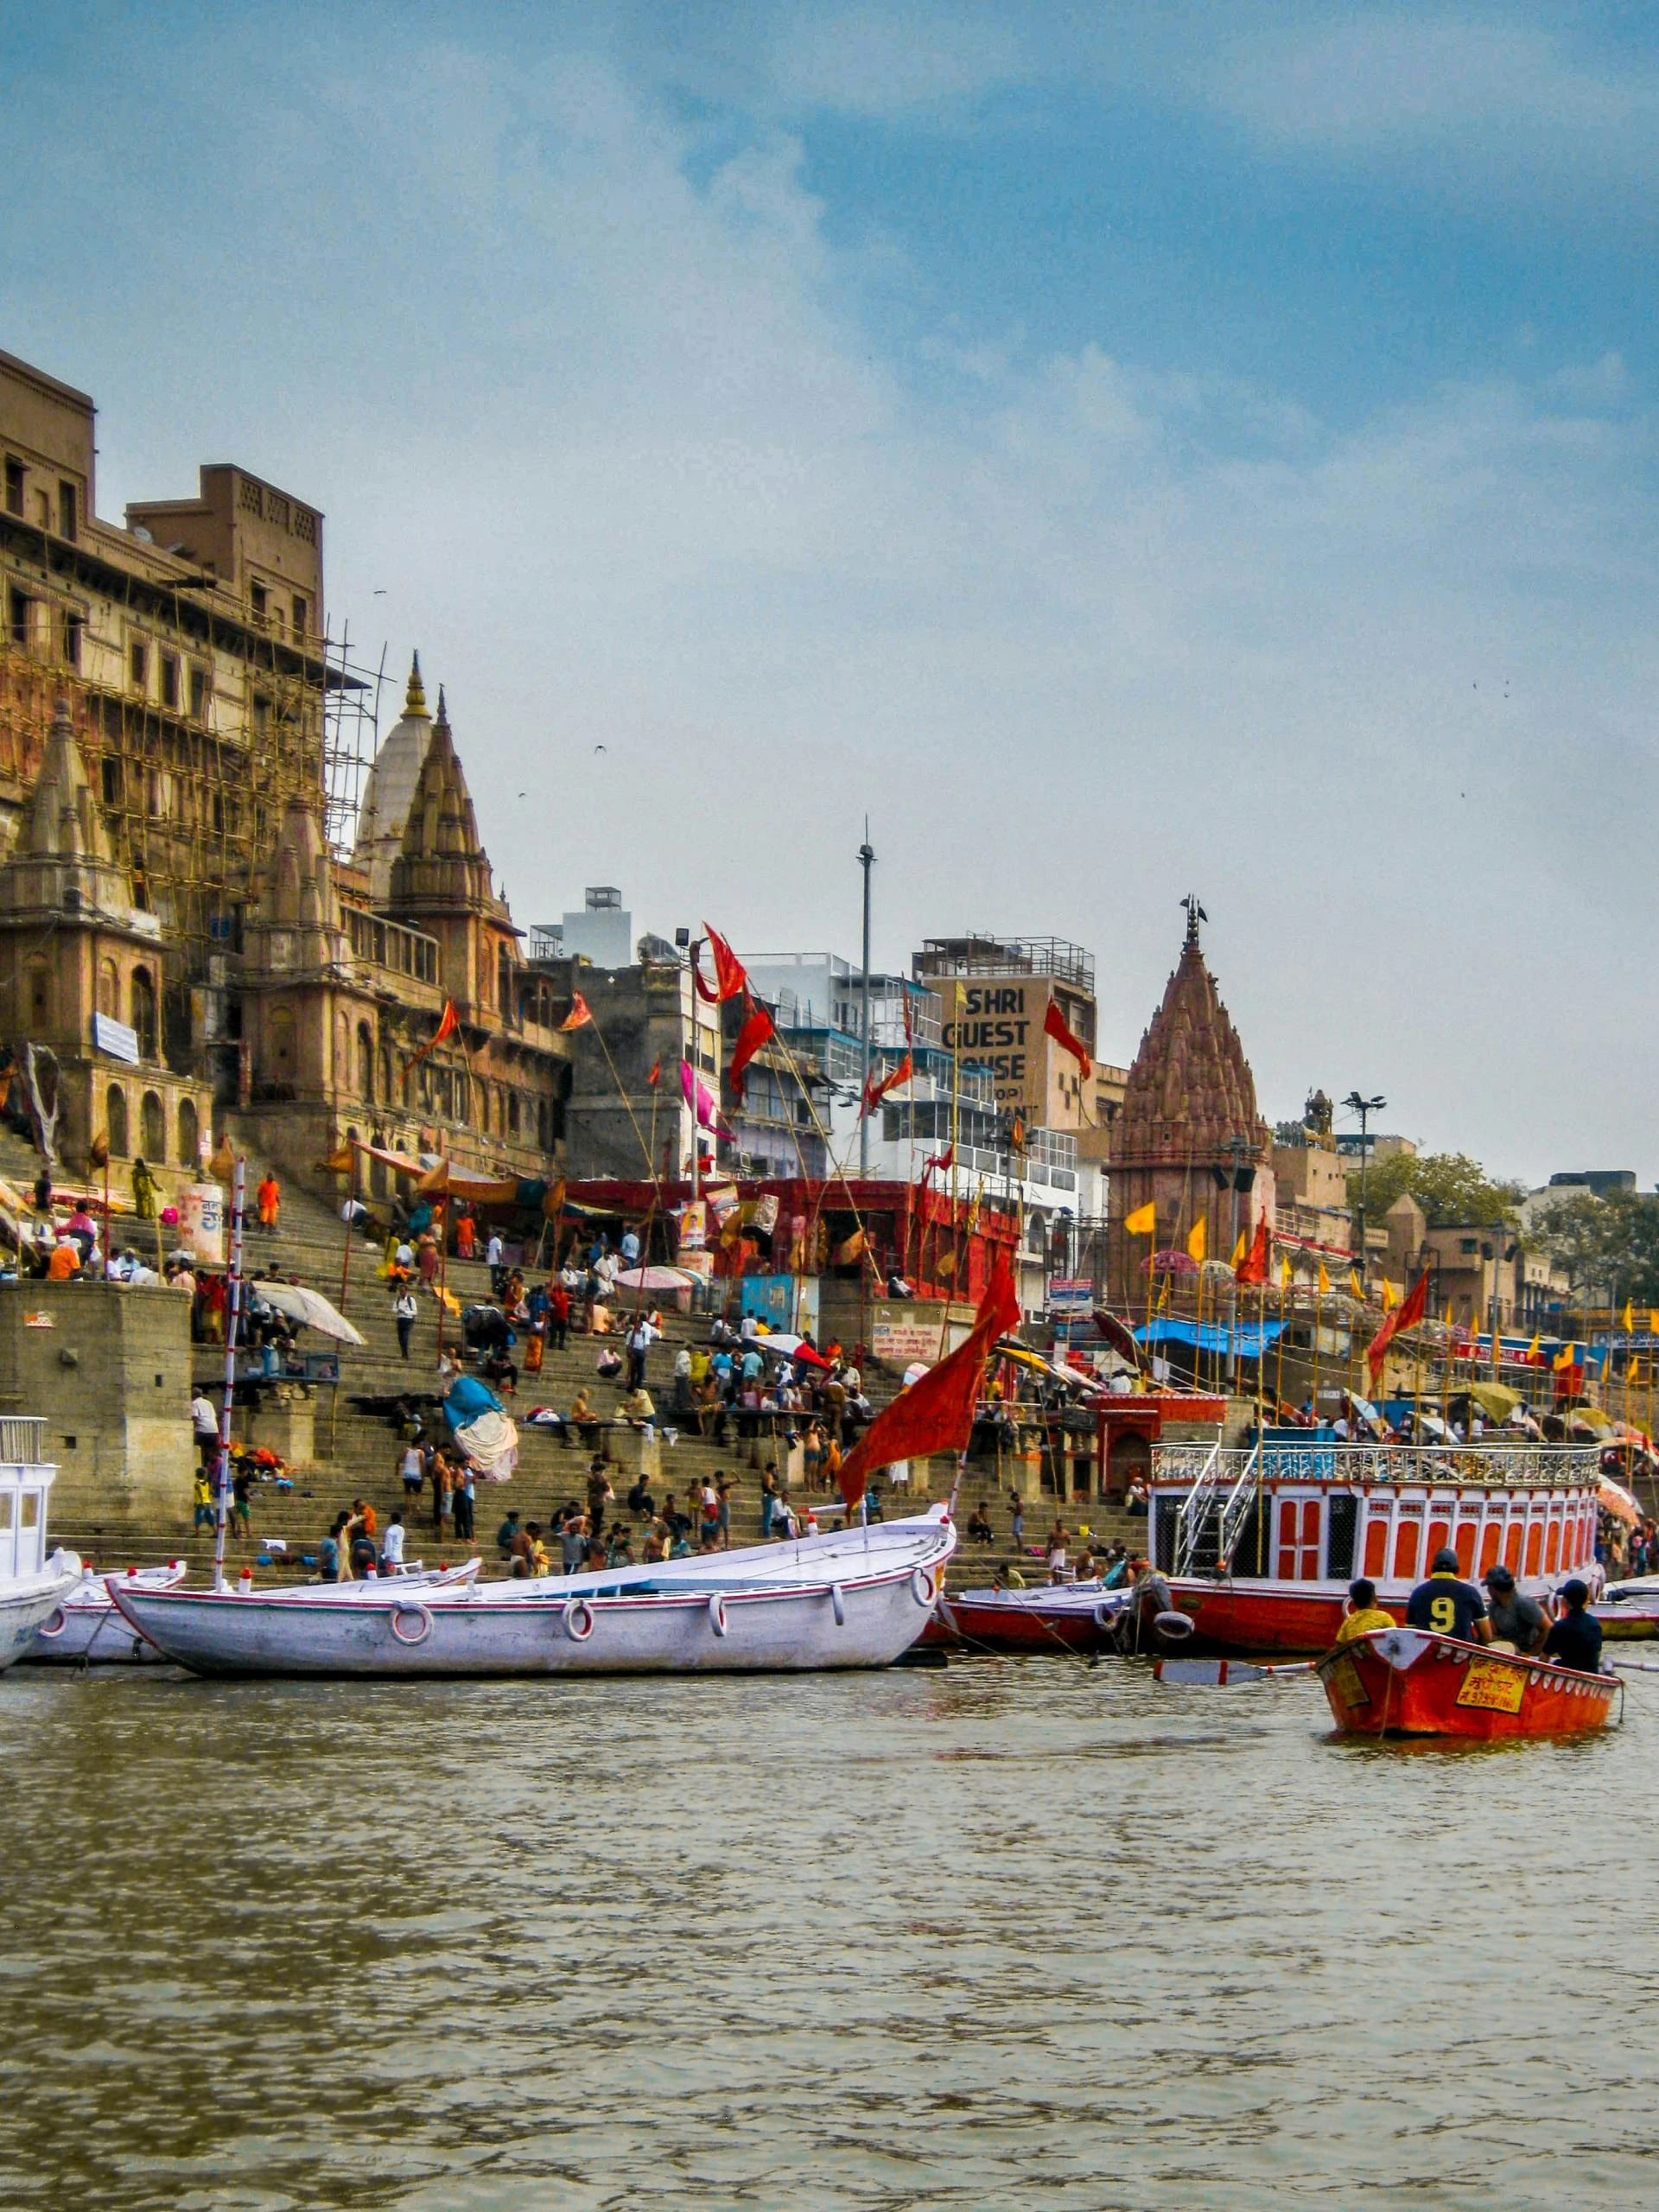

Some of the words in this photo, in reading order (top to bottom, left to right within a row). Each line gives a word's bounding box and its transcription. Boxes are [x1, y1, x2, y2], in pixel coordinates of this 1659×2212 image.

[965, 988, 1025, 1014] SHRI
[941, 1020, 1030, 1049] GUEST
[1429, 1597, 1455, 1633] 9
